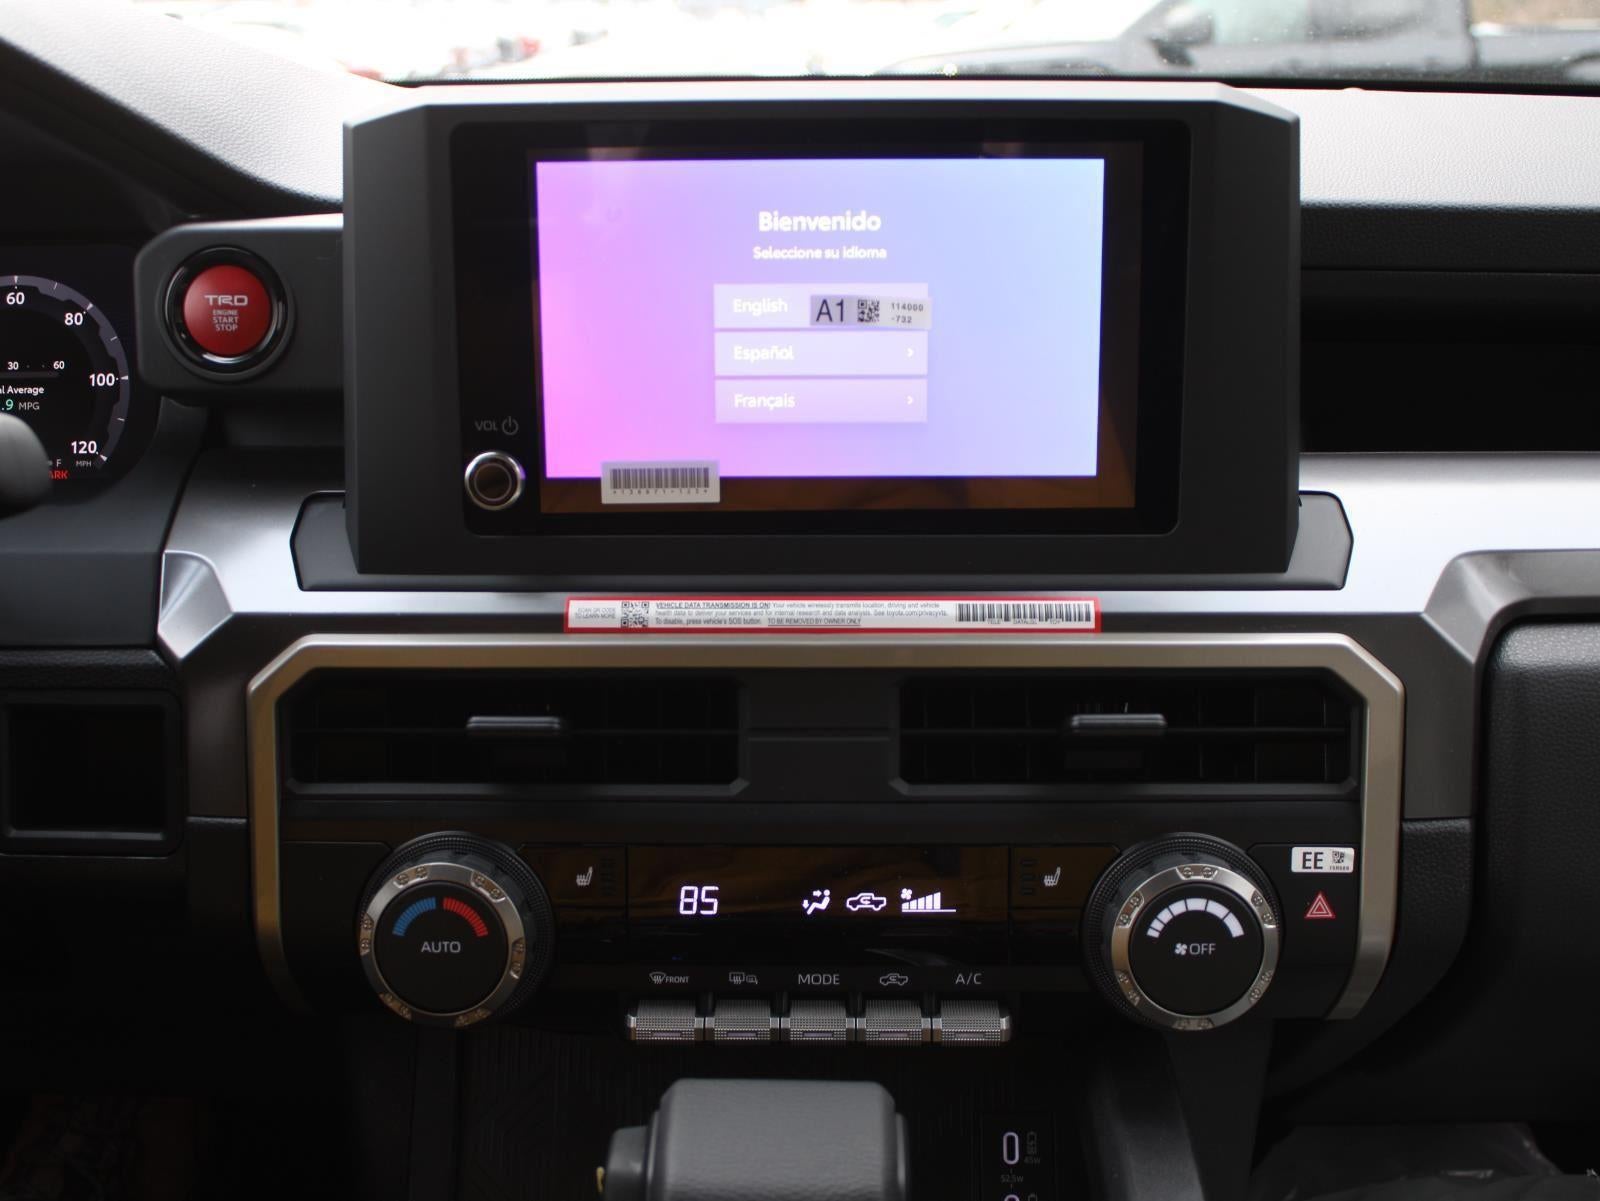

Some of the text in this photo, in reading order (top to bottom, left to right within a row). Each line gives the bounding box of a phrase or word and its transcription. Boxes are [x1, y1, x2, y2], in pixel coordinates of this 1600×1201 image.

[758, 210, 881, 232] Bienvenido
[753, 246, 887, 260] Seleccione su idioma
[7, 292, 25, 305] 60
[204, 295, 249, 306] TRD
[733, 298, 789, 316] English
[816, 299, 844, 322] A1
[65, 312, 83, 326] 80
[213, 316, 239, 324] START
[215, 324, 238, 332] STOP
[733, 344, 795, 362] Español
[7, 361, 19, 370] 30
[53, 360, 65, 370] 60
[89, 373, 115, 387] 100
[7, 385, 45, 396] Average
[18, 402, 40, 411] MPG
[734, 392, 796, 410] Français
[474, 420, 499, 431] VOL
[71, 440, 97, 454] 120
[56, 459, 62, 467] F
[686, 617, 702, 625] press
[729, 617, 742, 625] SOS
[768, 617, 776, 625] TO
[777, 617, 785, 625] BE
[785, 617, 815, 625] REMOVED
[815, 617, 823, 625] BY
[824, 617, 846, 625] OWNER
[847, 617, 861, 625] ONLY
[1302, 851, 1324, 870] EE
[680, 886, 720, 915] 85
[421, 941, 461, 953] AUTO
[1190, 943, 1216, 955] OFF
[665, 975, 690, 984] FRONT
[798, 974, 840, 985] MODE
[956, 972, 982, 985] A/C
